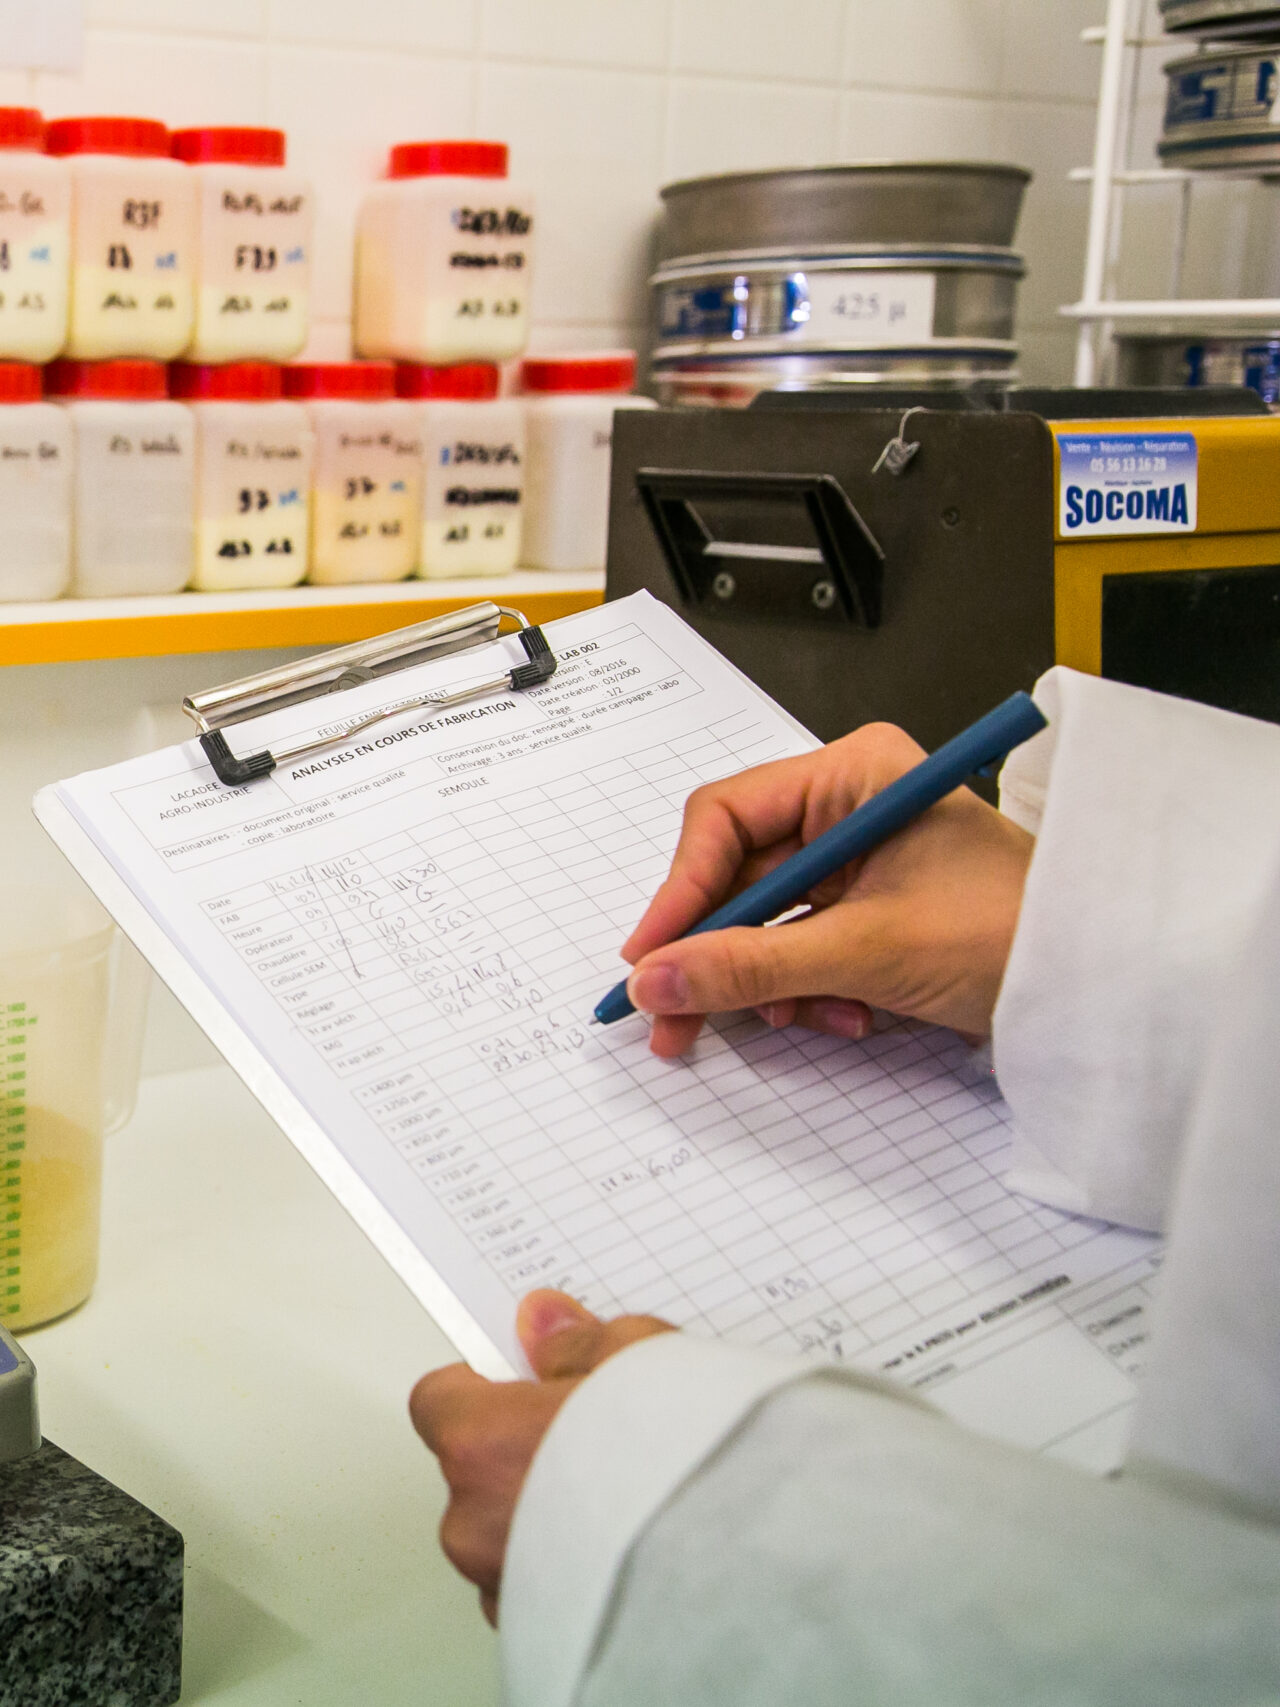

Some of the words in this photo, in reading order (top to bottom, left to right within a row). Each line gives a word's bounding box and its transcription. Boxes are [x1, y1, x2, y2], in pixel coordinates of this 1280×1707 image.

[832, 292, 880, 320] 425
[1066, 483, 1188, 528] SOCOMA
[560, 648, 580, 661] LAB
[580, 642, 600, 656] 002
[528, 685, 551, 699] Date
[552, 674, 585, 691] version
[589, 658, 627, 678] 08/2016
[538, 695, 560, 708] Date
[561, 680, 598, 700] création
[602, 666, 641, 686] 03/2000
[548, 704, 571, 718] Page
[608, 686, 623, 698] 1/2
[437, 739, 497, 763] Conservation
[498, 736, 511, 747] du
[532, 716, 575, 735] renseigné
[581, 703, 607, 720] durée
[608, 688, 653, 712] campagne
[658, 679, 680, 693] labo
[291, 751, 354, 780] ANALYSES
[355, 744, 372, 756] EN
[375, 727, 418, 749] COURS
[420, 721, 436, 733] DE
[437, 699, 516, 727] FABRICATION
[447, 753, 493, 775] Archivage
[497, 751, 505, 760] 3
[507, 748, 523, 759] ans
[529, 734, 560, 750] service
[561, 724, 593, 742] qualité
[437, 776, 489, 798] SEMOULE
[159, 786, 251, 821] AGRO-INDUSTRIE
[163, 832, 230, 858] Destinataires
[243, 811, 294, 834] document
[294, 798, 331, 817] original
[337, 784, 372, 802] service
[373, 769, 406, 789] qualité
[247, 832, 274, 846] copie
[280, 811, 336, 835] laboratoire
[207, 897, 231, 911] Date
[220, 914, 240, 925] FAB
[232, 925, 263, 942] Heure
[244, 933, 294, 956] Opérateur
[257, 949, 307, 973] Chaudière
[270, 971, 303, 988] Cellule
[304, 962, 328, 976] SEM
[283, 989, 309, 1005] Type
